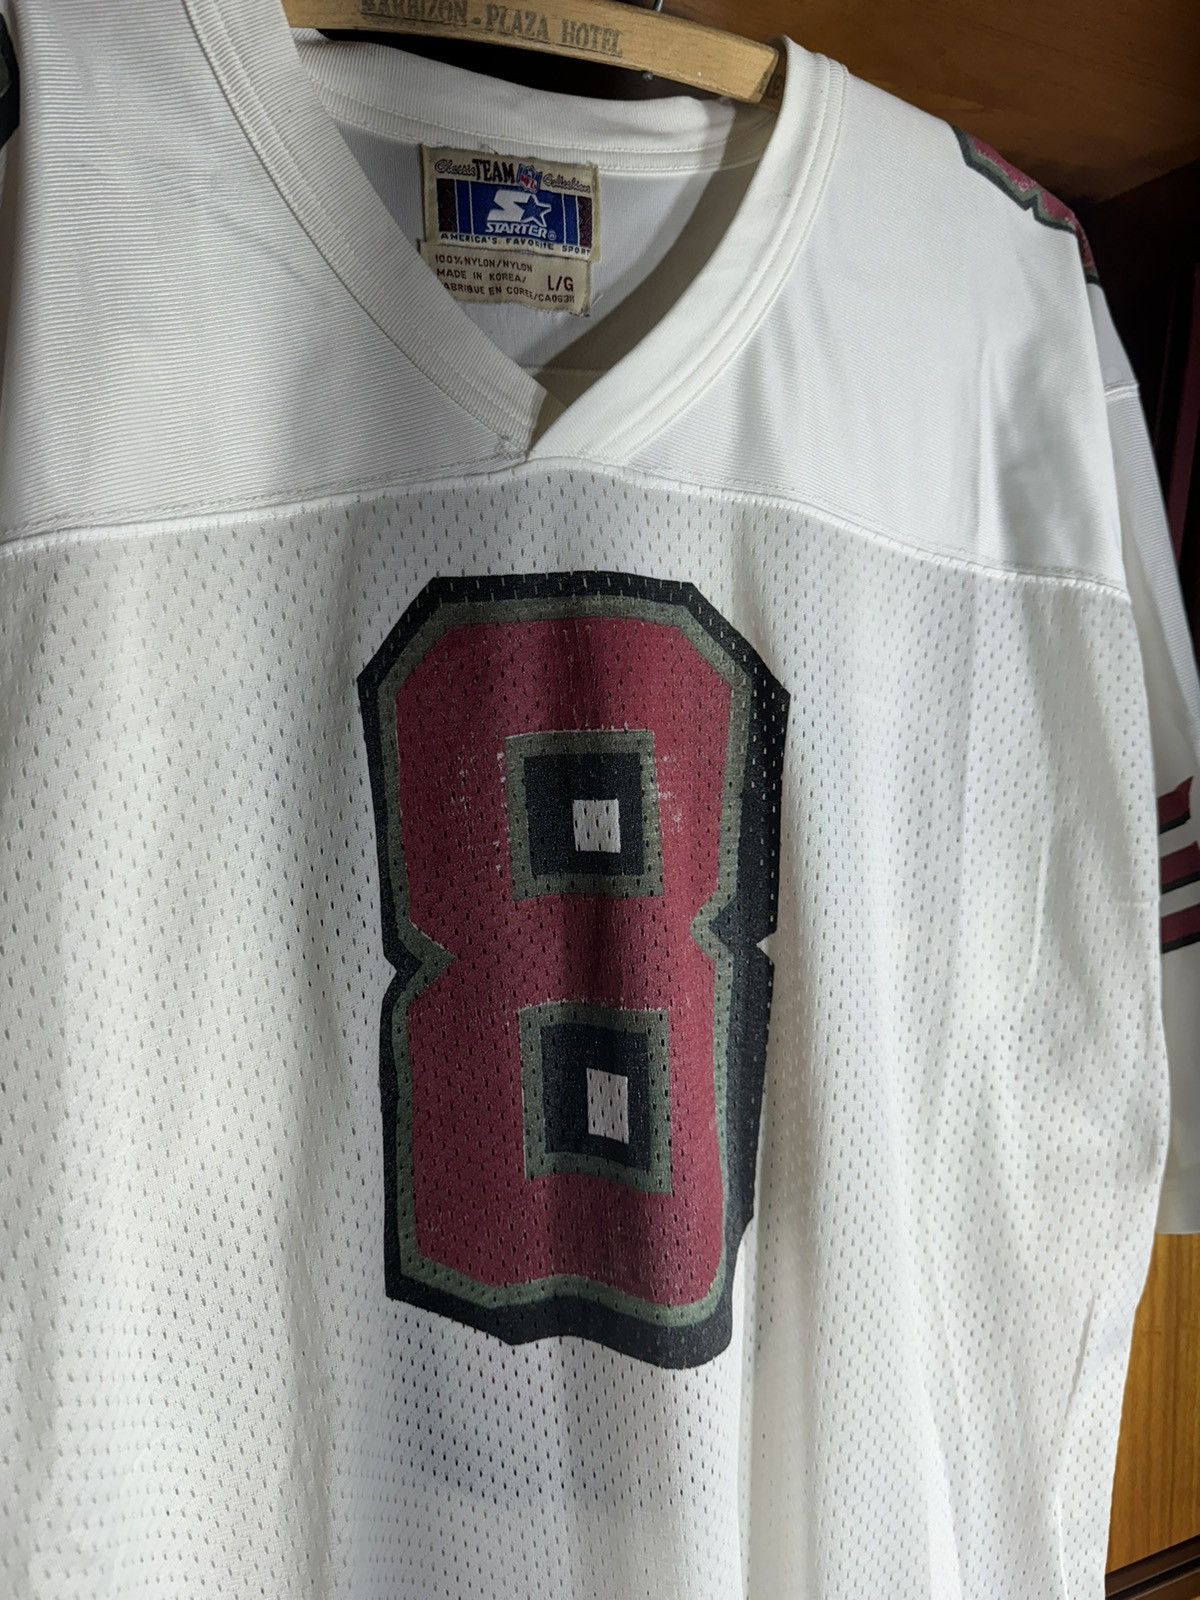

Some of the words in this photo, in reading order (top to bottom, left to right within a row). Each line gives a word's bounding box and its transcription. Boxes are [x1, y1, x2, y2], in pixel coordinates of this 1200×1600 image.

[560, 18, 622, 56] HOTEL
[472, 158, 515, 184] TEAM
[440, 232, 498, 245] AMERICA'S
[505, 237, 554, 251] FAVORITE
[436, 267, 467, 280] MADE
[472, 271, 483, 281] IN
[547, 274, 574, 292] L/G
[441, 281, 485, 295] ABRIQUE
[488, 286, 503, 296] EN
[357, 570, 790, 1370] 8
